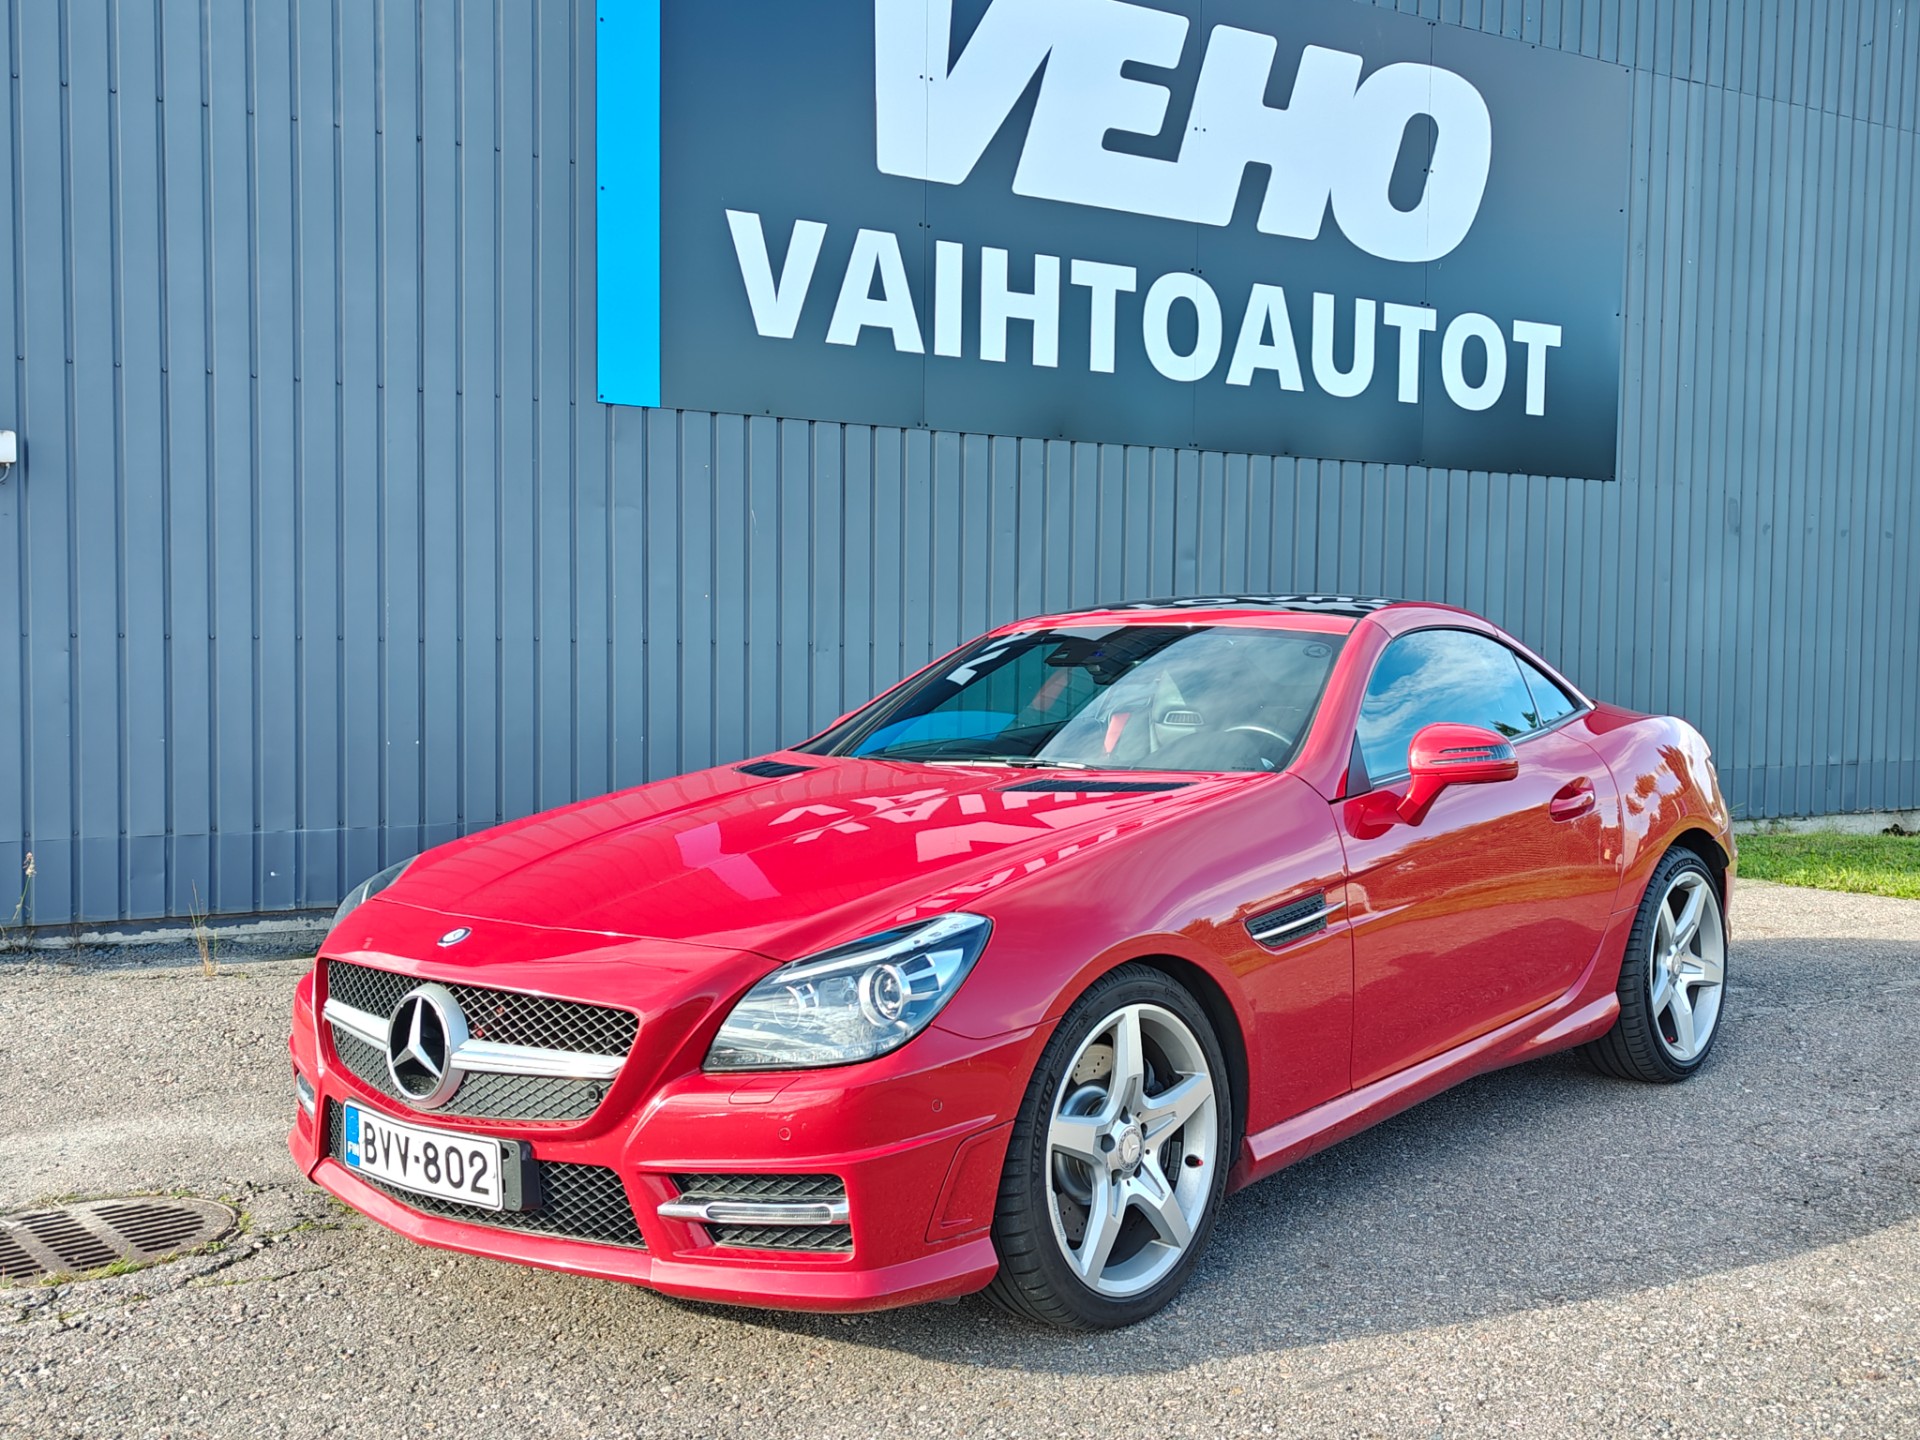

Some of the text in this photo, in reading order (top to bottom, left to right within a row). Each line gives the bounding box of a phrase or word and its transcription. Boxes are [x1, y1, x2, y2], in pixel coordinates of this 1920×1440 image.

[875, 0, 1492, 263] VEHO
[725, 209, 1563, 416] VAIHTOAUTOT
[364, 1121, 489, 1195] BVV-802
[1031, 1078, 1055, 1174] MICHELIN
